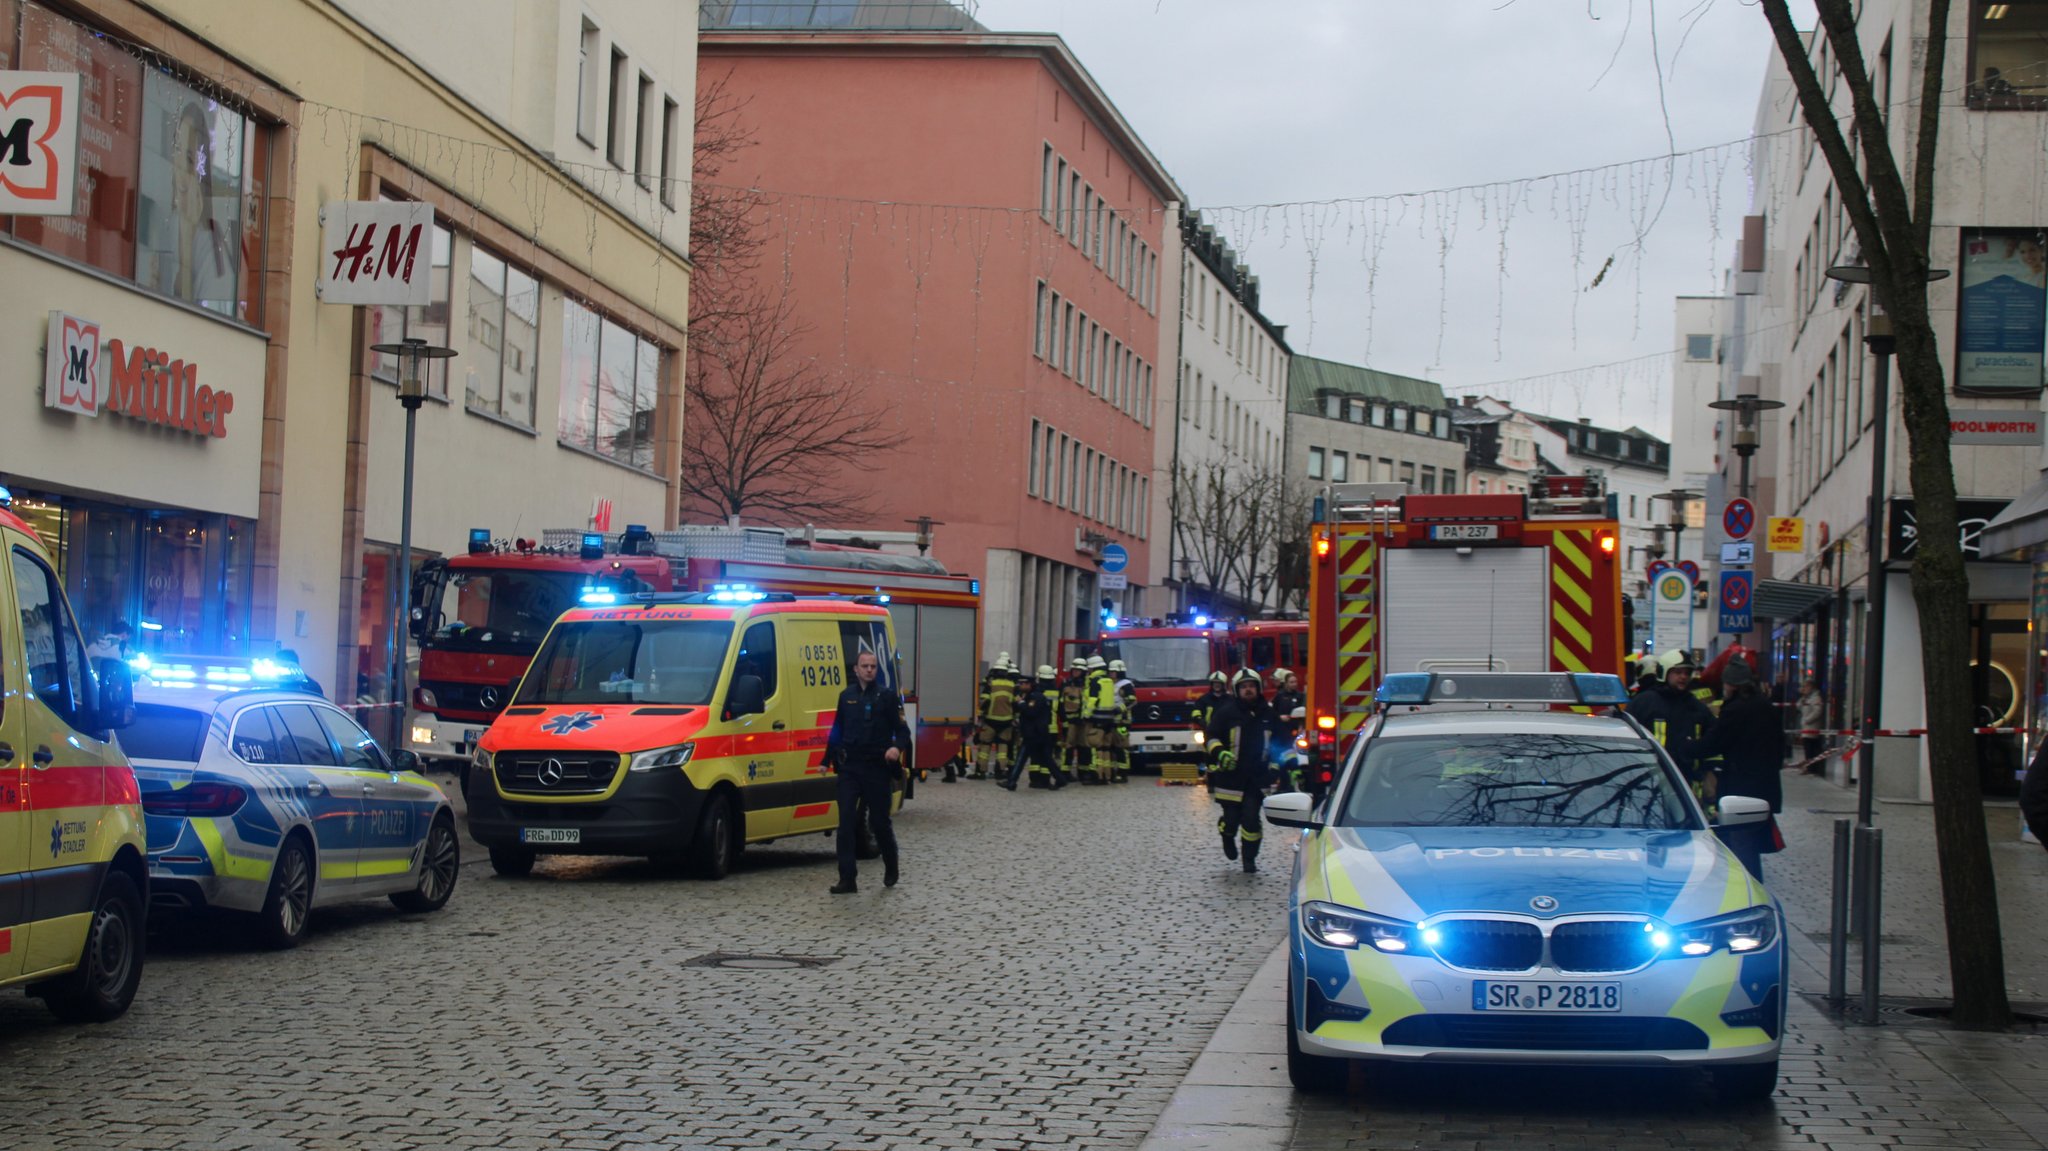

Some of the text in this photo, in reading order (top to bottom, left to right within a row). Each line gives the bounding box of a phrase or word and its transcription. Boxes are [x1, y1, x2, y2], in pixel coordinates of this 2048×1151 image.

[333, 222, 423, 285] H&M
[69, 345, 88, 384] M
[106, 338, 234, 438] Müller
[1949, 420, 2036, 433] WOOLWORTH
[1443, 526, 1489, 537] PA 237
[1771, 535, 1800, 544] LOTTO
[592, 611, 692, 620] RETTUNG
[1721, 614, 1749, 628] TAXI
[801, 665, 841, 687] 19 218
[248, 744, 265, 760] 110
[63, 821, 87, 835] RETTUNG
[370, 809, 407, 836] POLIZEI
[525, 829, 545, 841] FRG
[62, 839, 86, 854] STADLER
[1433, 847, 1640, 862] POLIZEI
[1489, 984, 1519, 1007] SR
[1538, 985, 1552, 1007] P
[1558, 985, 1617, 1009] 2818
